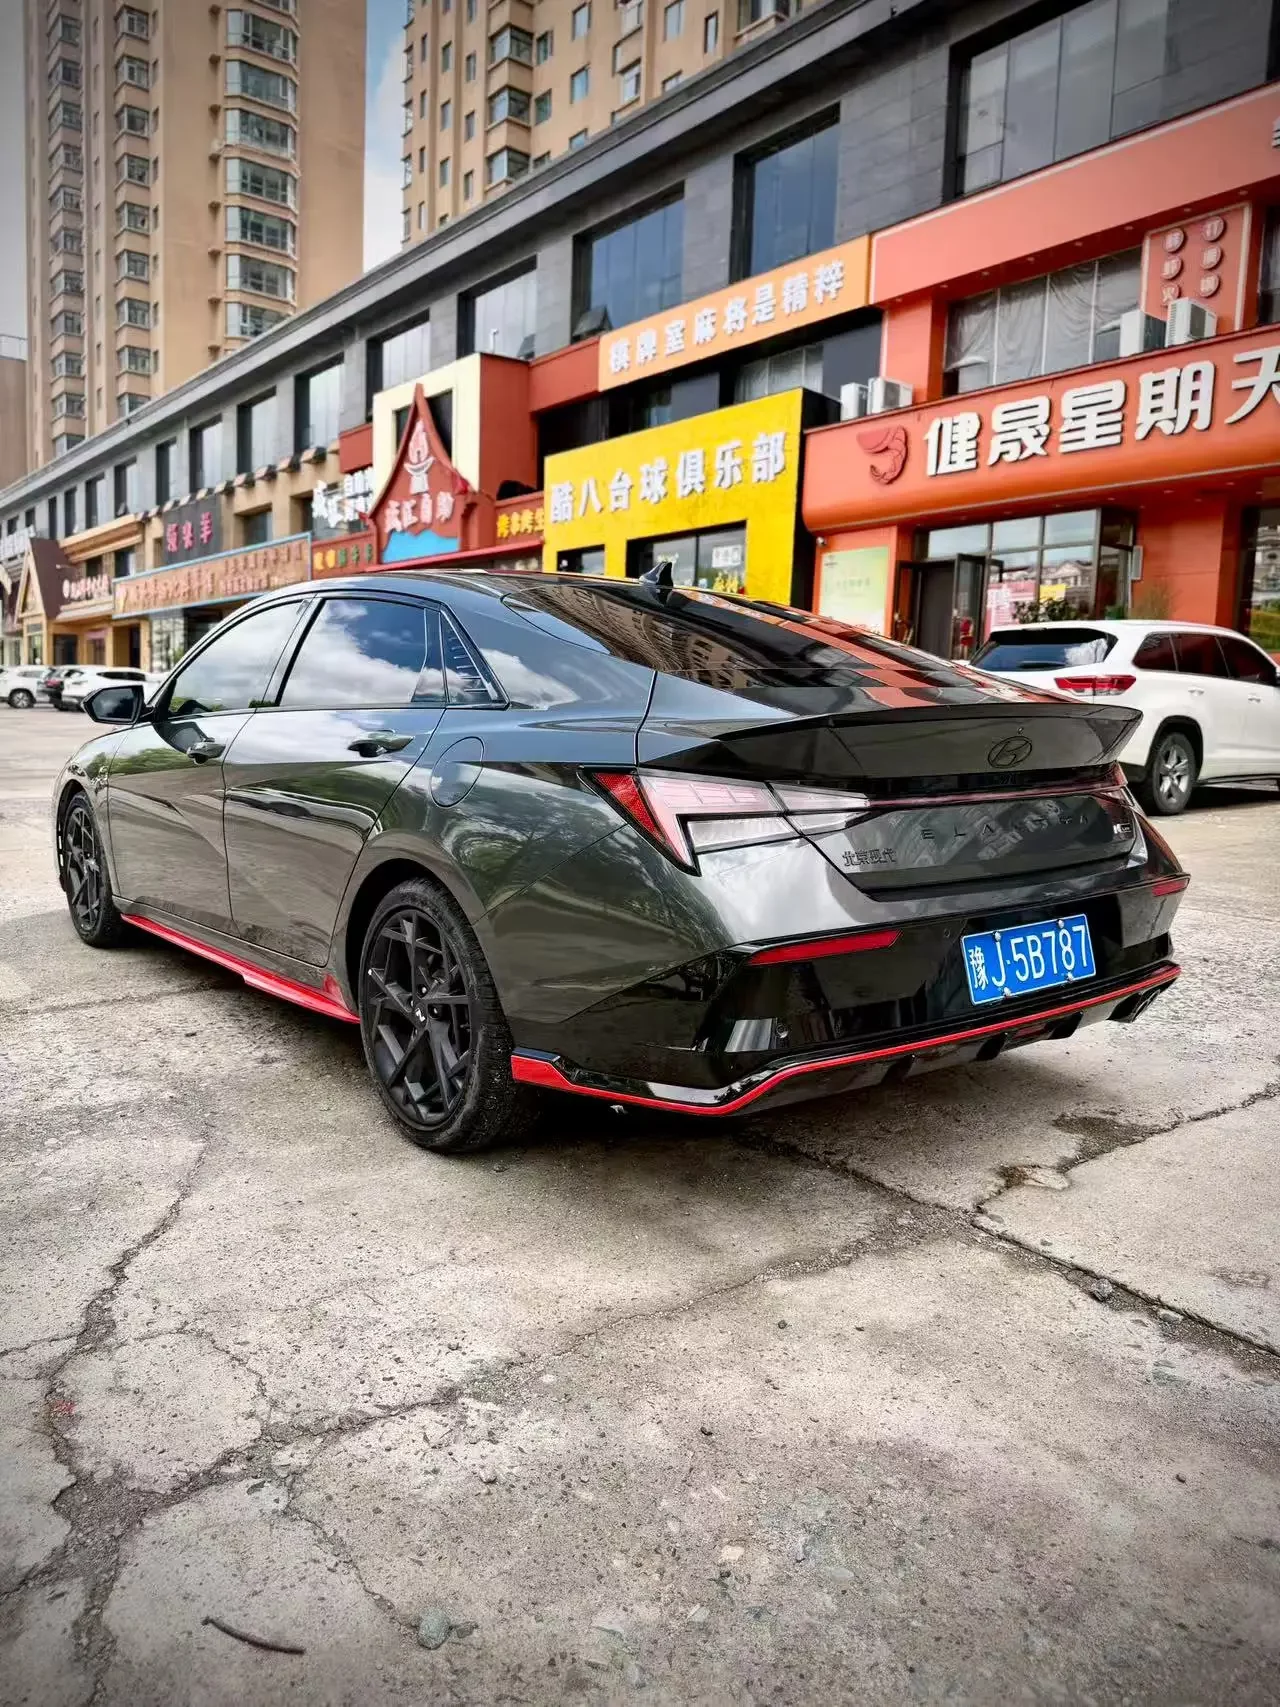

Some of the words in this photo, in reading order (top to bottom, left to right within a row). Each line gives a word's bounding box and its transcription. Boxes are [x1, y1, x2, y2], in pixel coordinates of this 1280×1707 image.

[549, 431, 788, 525] 酷八台球俱乐部
[841, 847, 897, 867] 北京现代
